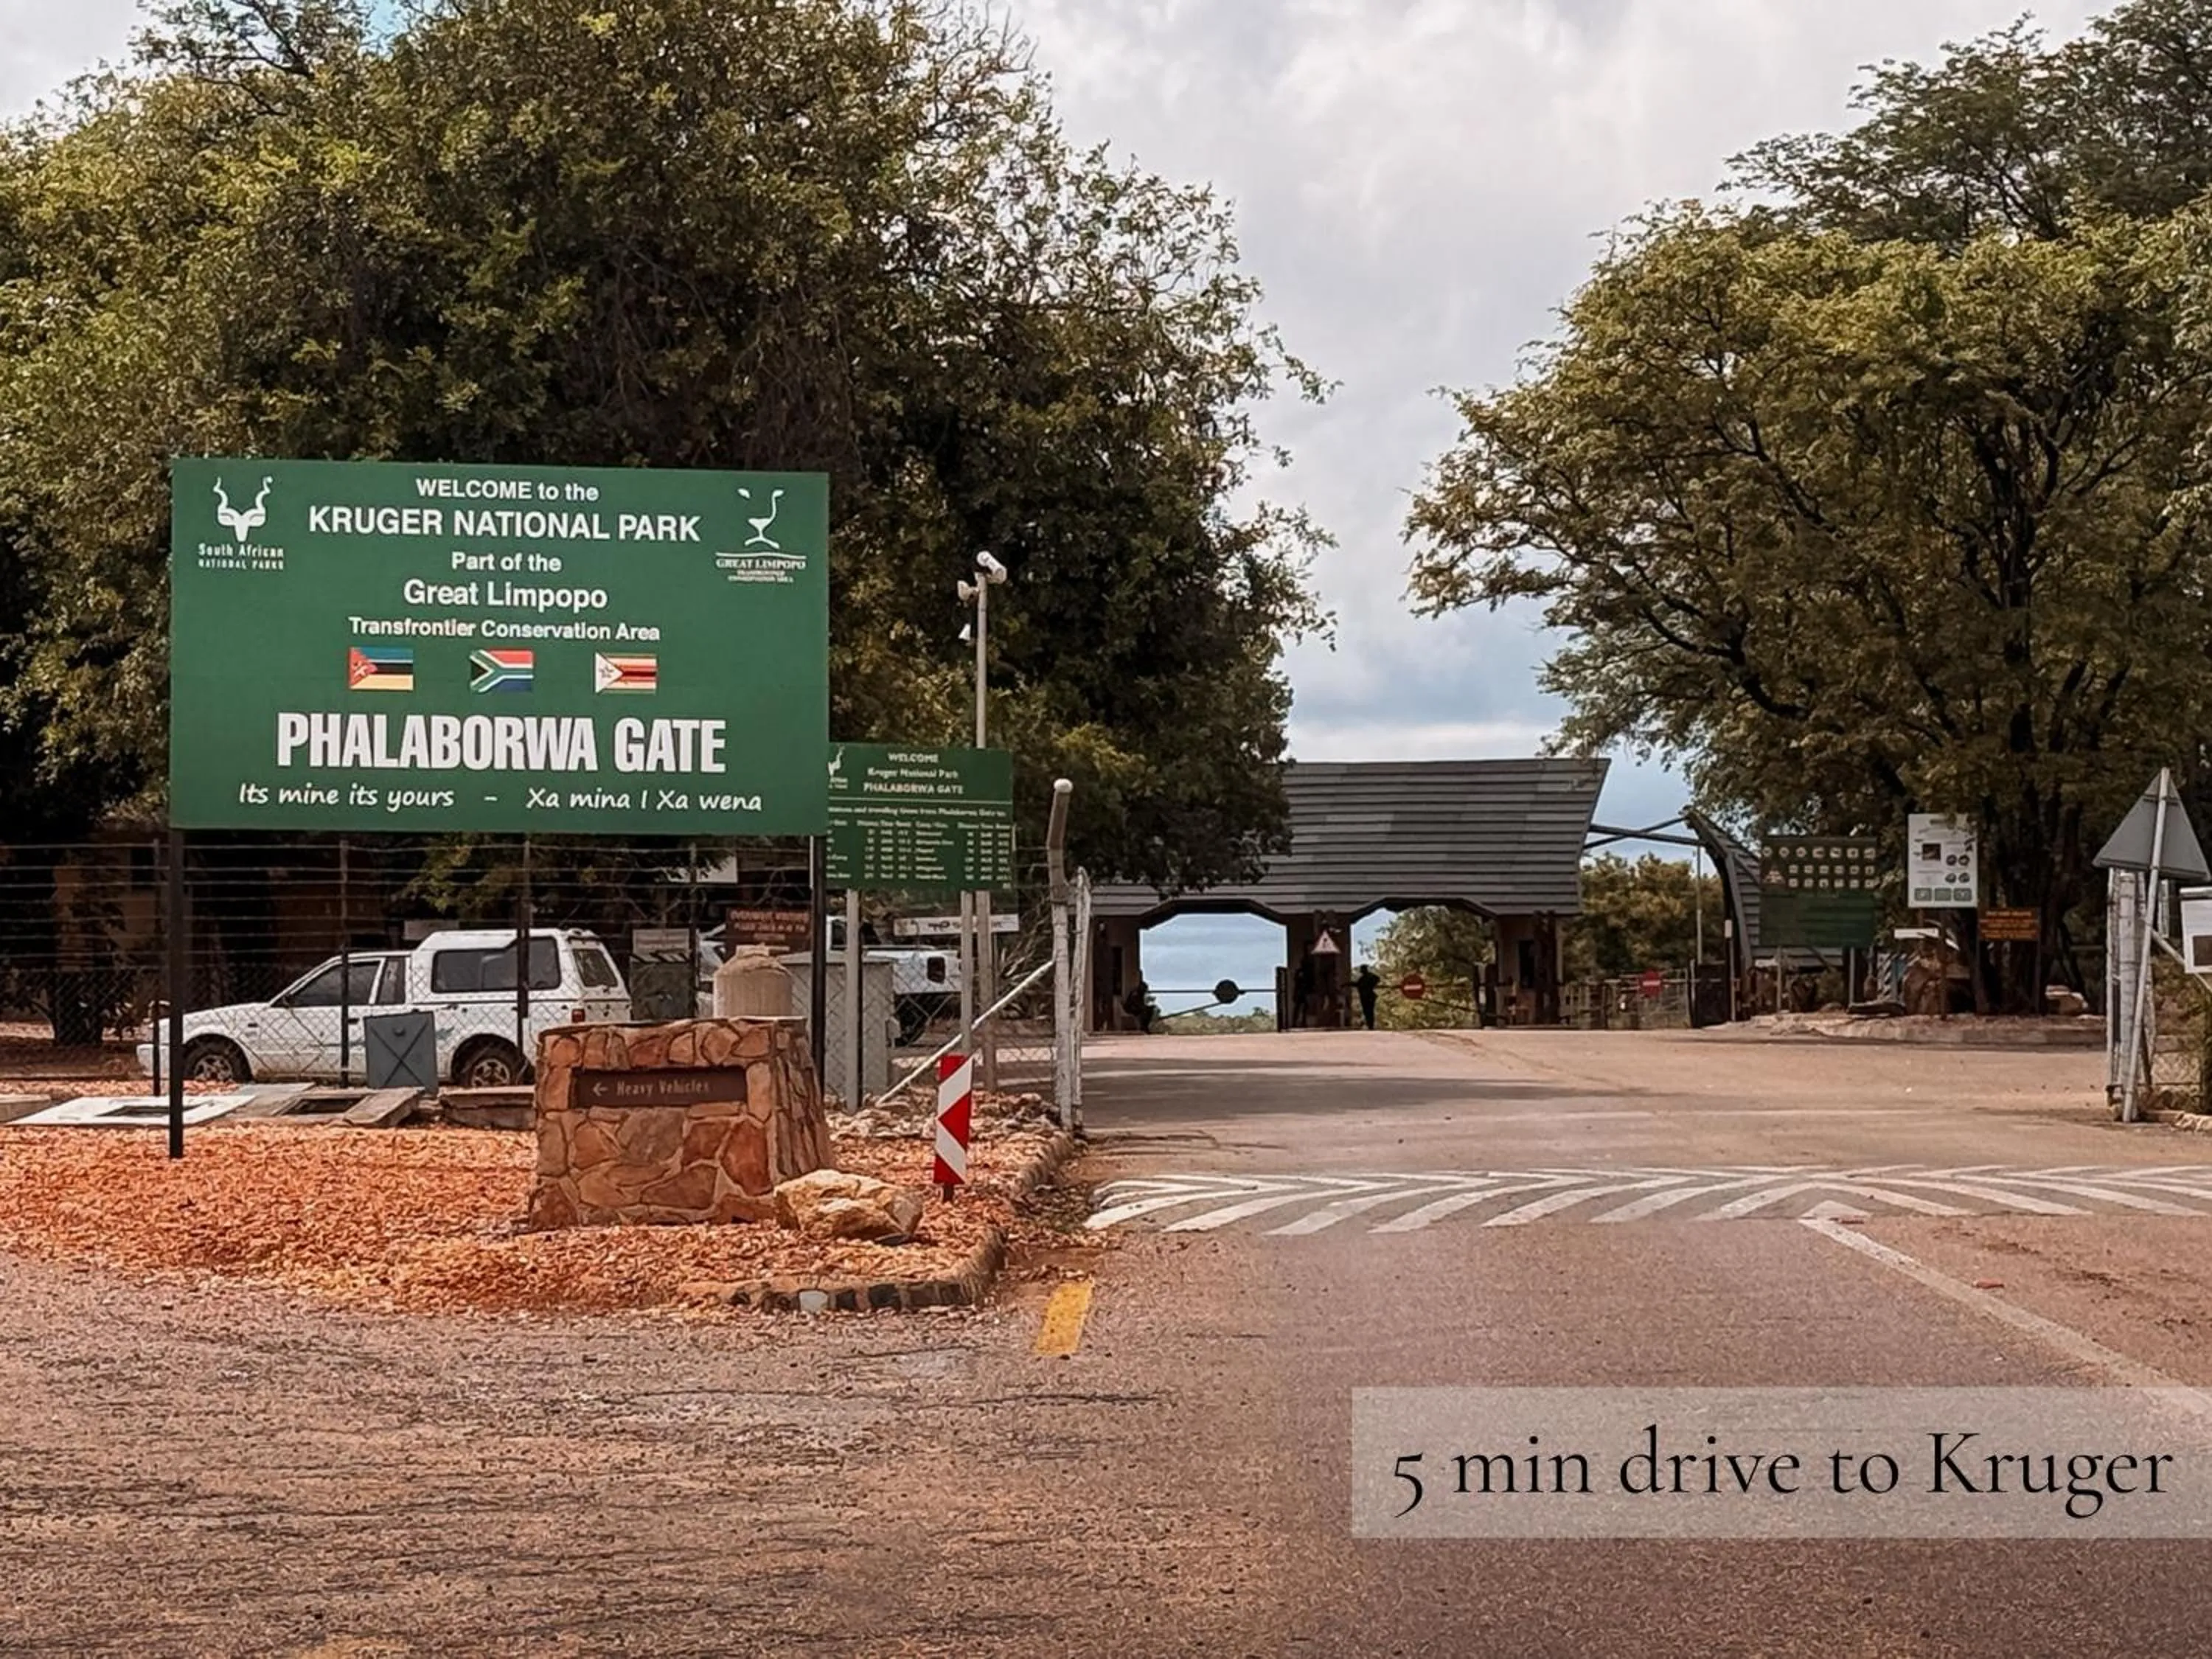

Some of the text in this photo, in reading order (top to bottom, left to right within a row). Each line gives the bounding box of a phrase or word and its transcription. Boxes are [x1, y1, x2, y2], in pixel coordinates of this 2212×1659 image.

[416, 478, 599, 502] WELCOME to the
[309, 505, 700, 542] KRUGER NATIONAL PARK
[451, 551, 563, 573] Part of the
[403, 578, 608, 613] Great Limpopo
[348, 616, 661, 641] Transfrontier Conservation Area
[277, 712, 726, 773] PHALABORWA GATE
[239, 782, 268, 805] Its
[279, 782, 340, 805] mine
[348, 782, 378, 806] its
[386, 790, 454, 813] yours
[526, 787, 560, 809] Xa
[570, 787, 631, 809] mina
[655, 790, 689, 810] Xa
[698, 794, 762, 812] wena
[616, 1079, 709, 1098] Heavy Vehicles
